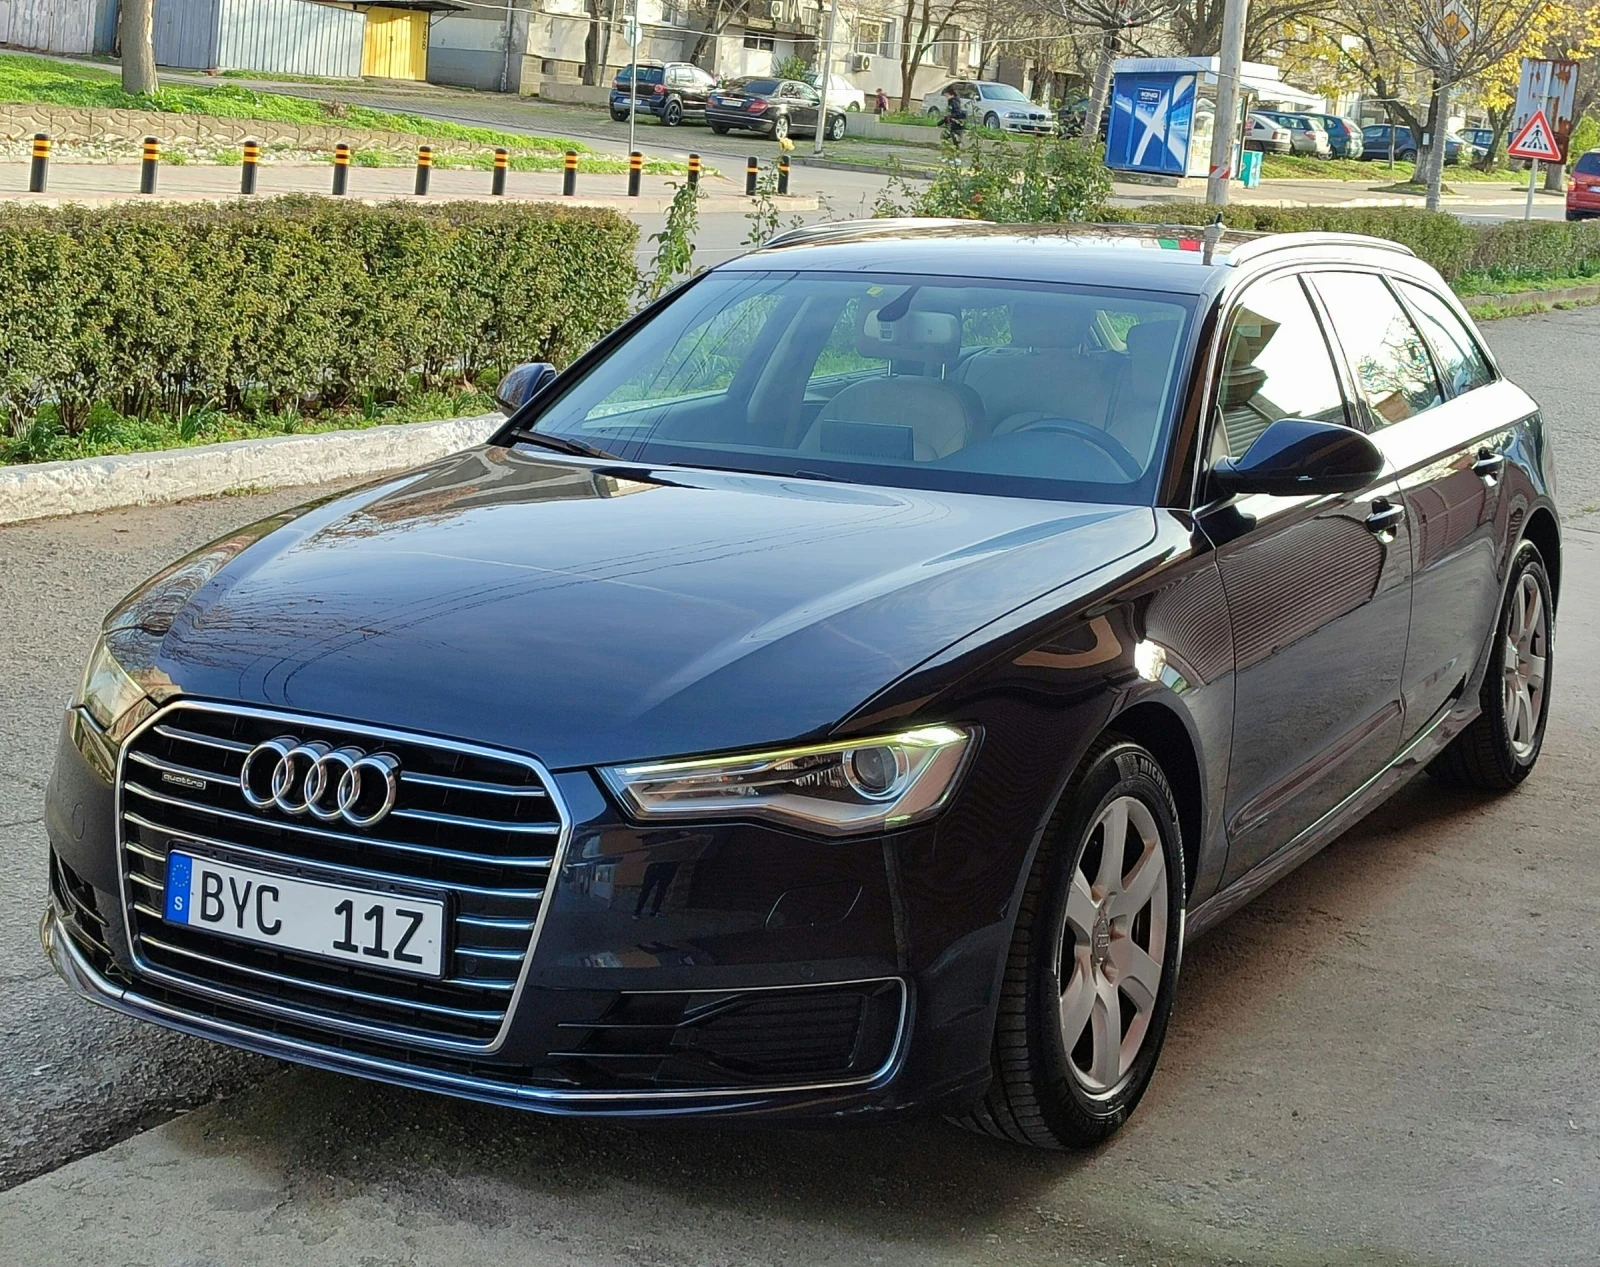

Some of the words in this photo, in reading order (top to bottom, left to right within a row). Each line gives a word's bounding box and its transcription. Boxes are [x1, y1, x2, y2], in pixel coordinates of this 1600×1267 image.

[163, 773, 203, 788] quattro
[1140, 757, 1178, 821] MICHELIN
[174, 896, 184, 911] S
[200, 870, 282, 936] BYC
[332, 899, 424, 965] 11Z
